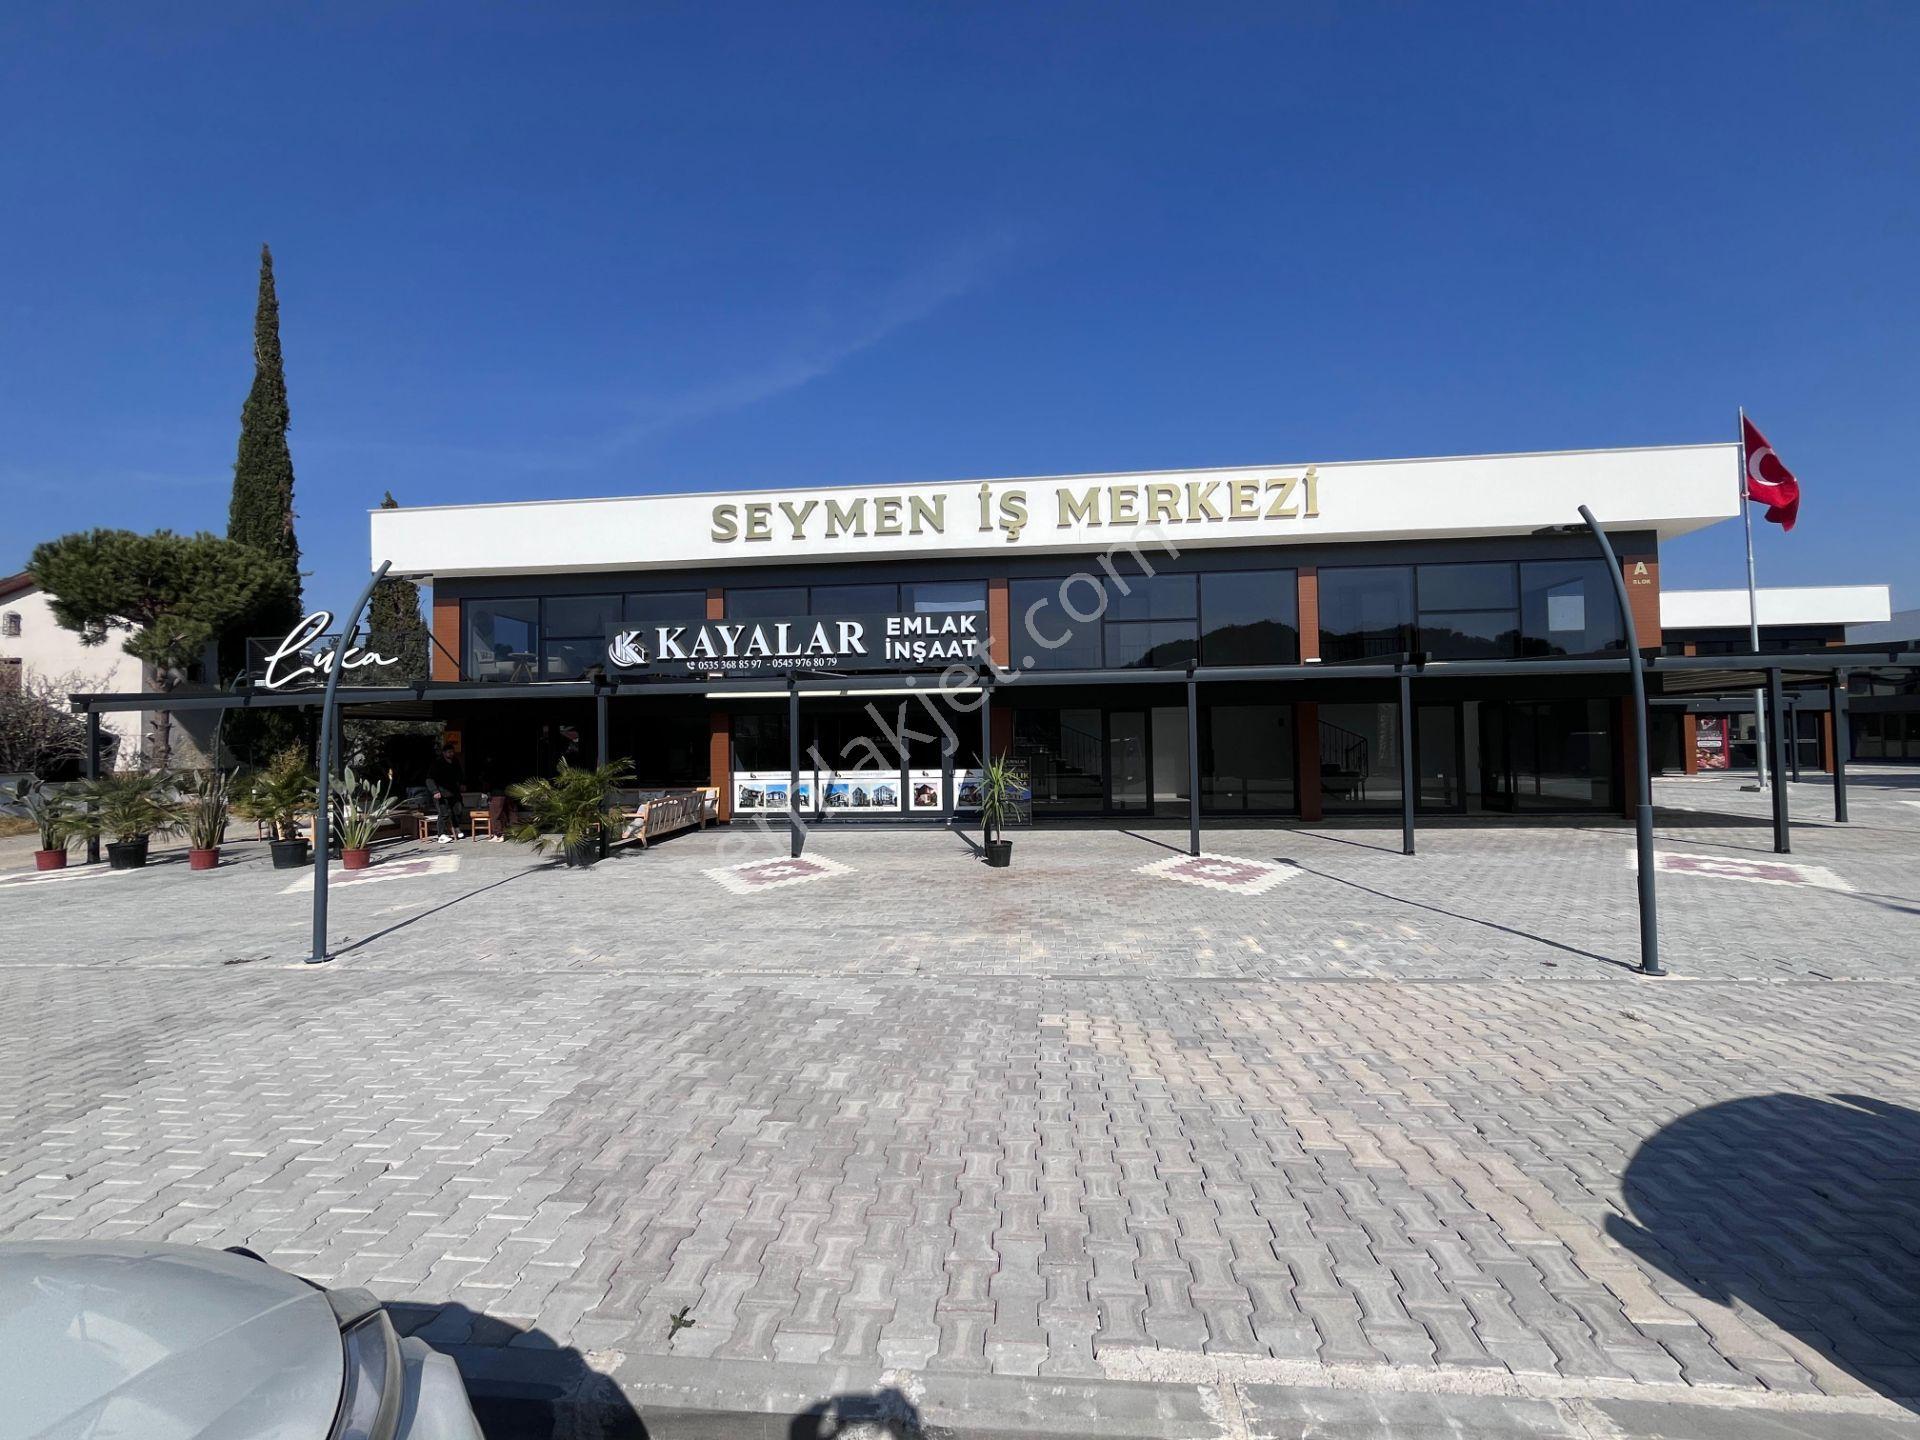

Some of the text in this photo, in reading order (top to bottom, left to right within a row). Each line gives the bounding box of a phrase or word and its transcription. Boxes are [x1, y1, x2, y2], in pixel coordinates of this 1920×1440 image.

[711, 464, 1320, 543] SEYMEN İŞ MERKEZİ
[1634, 561, 1648, 575] A
[886, 615, 976, 636] EMLAK
[655, 621, 869, 660] KAYALAR
[885, 637, 977, 664] İNŞAAT
[698, 661, 719, 670] 0535
[721, 660, 736, 669] 368
[738, 659, 749, 668] 85
[751, 659, 762, 668] 97
[772, 658, 793, 668] 0545
[795, 657, 811, 667] 976
[813, 657, 824, 666] 80
[826, 657, 837, 666] 79
